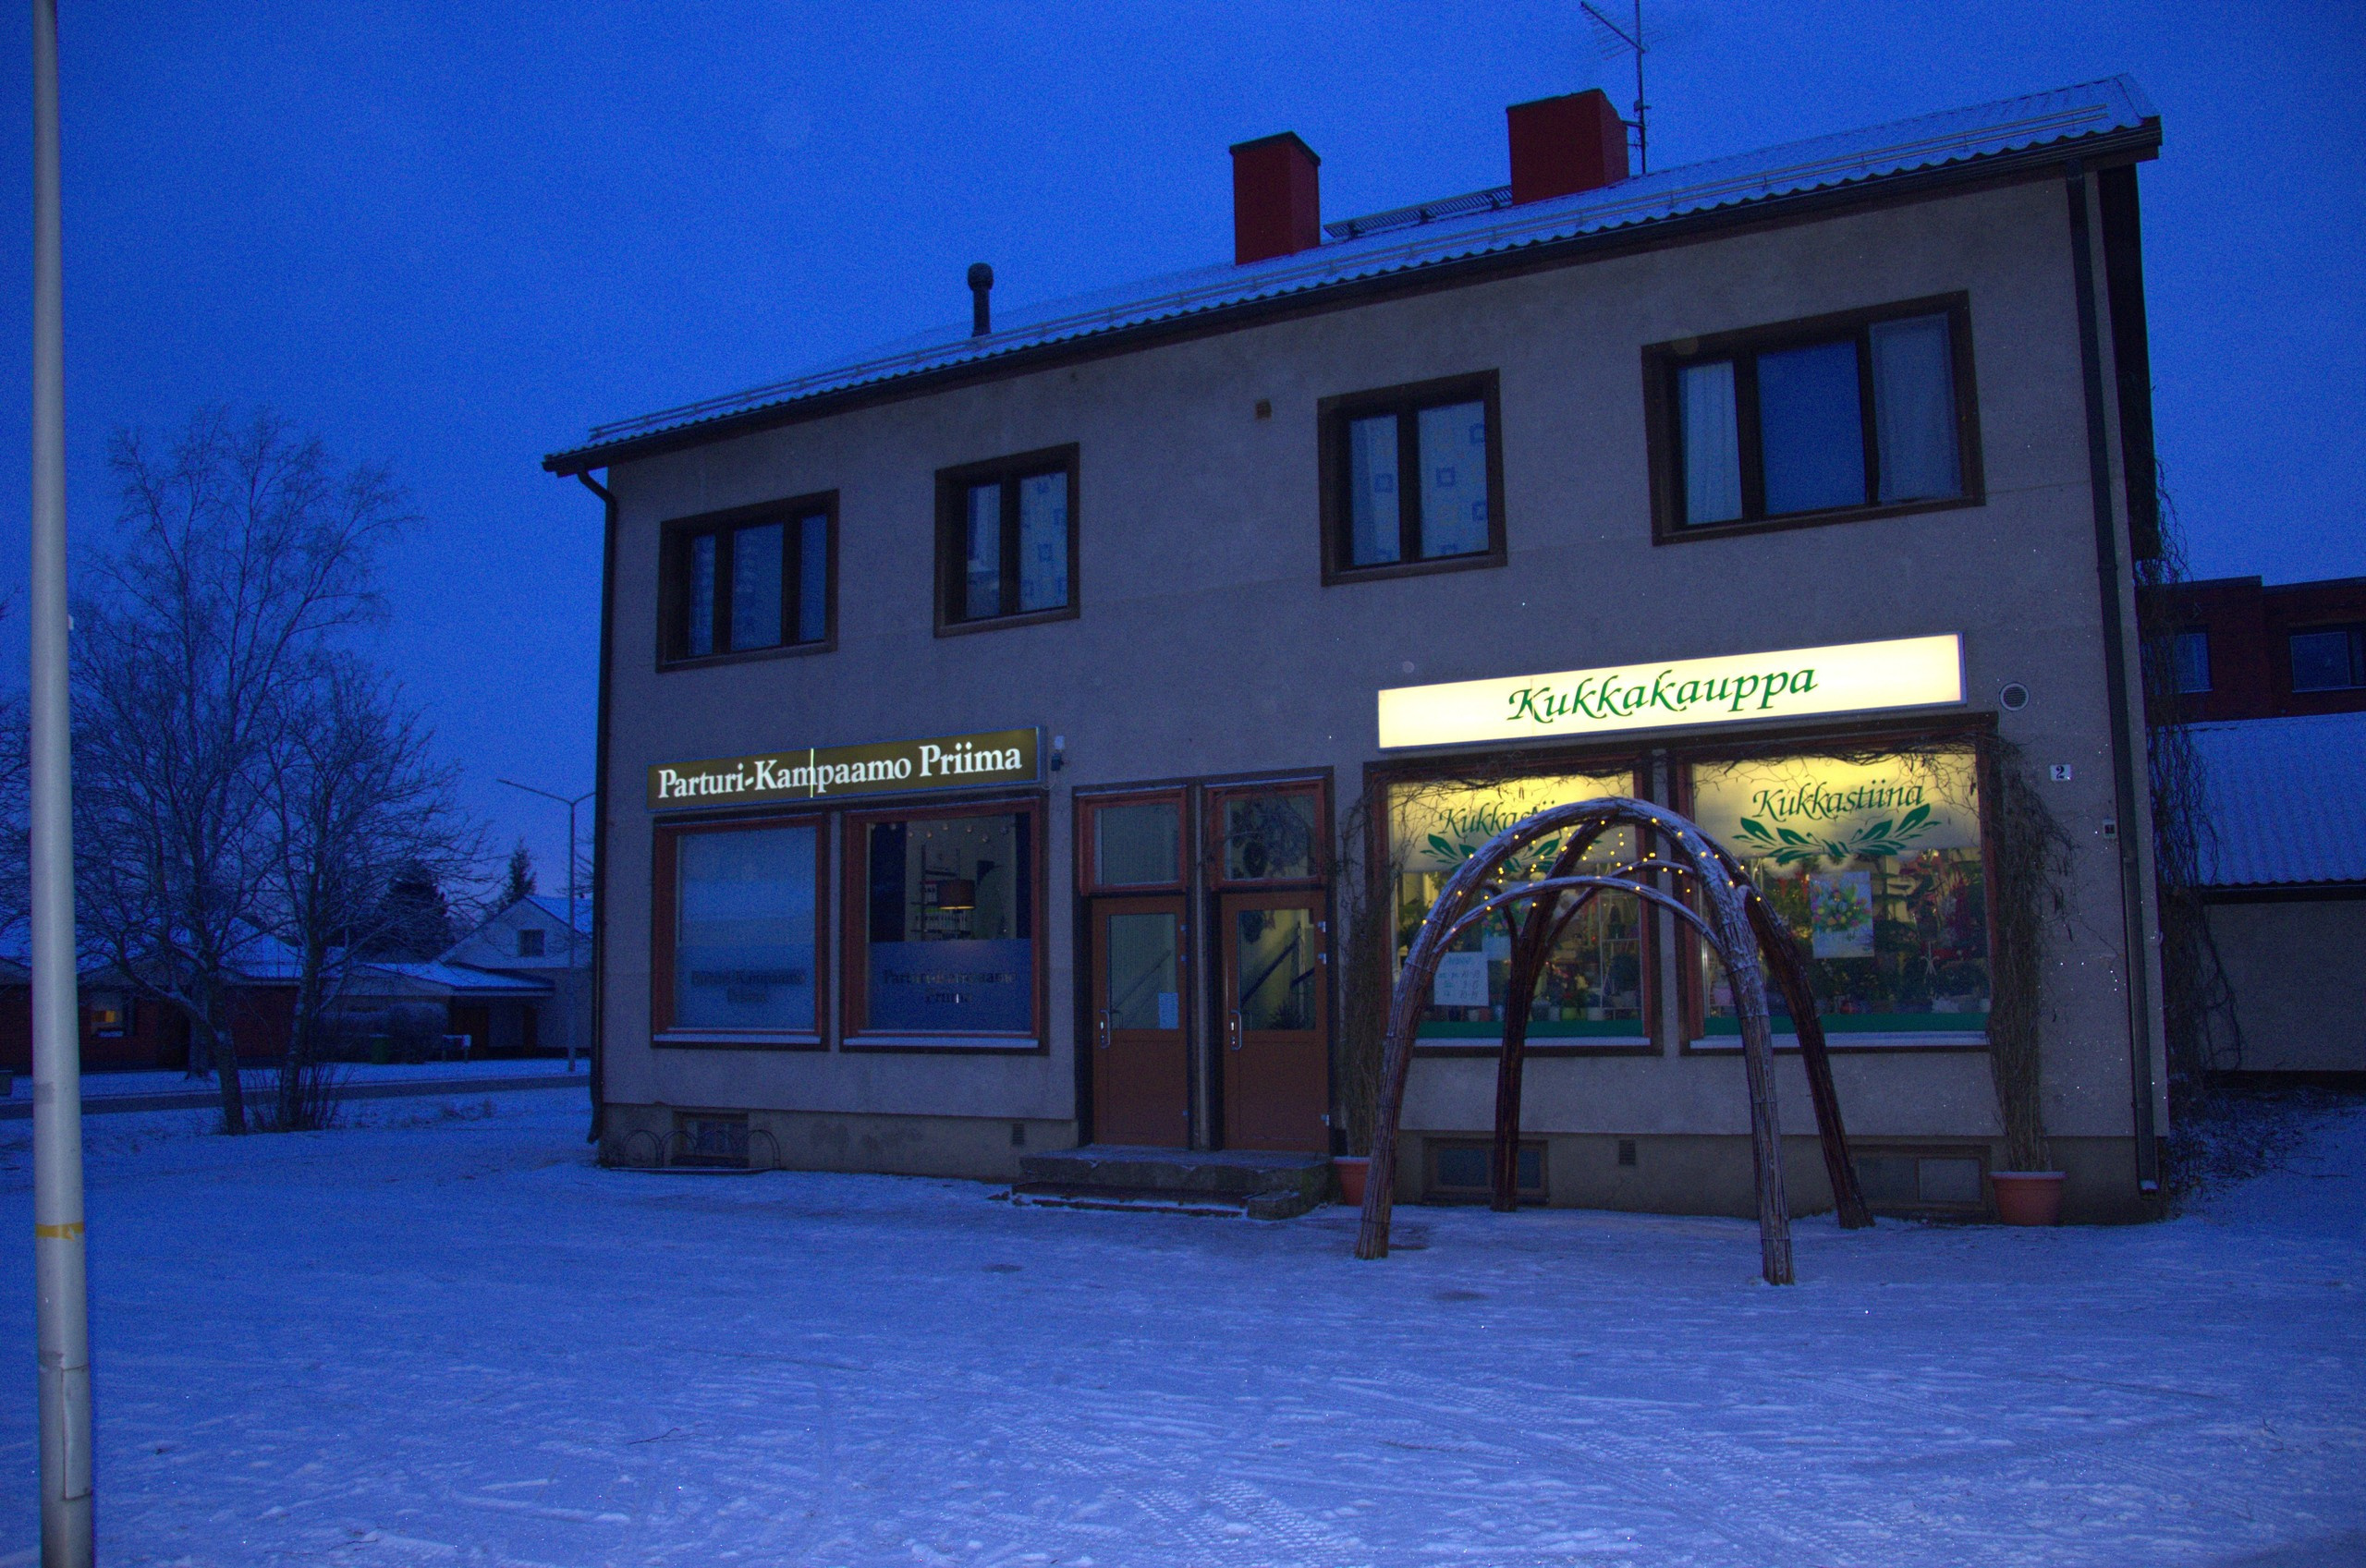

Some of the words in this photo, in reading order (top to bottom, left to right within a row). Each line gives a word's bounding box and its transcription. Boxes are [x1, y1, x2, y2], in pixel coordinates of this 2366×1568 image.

[1507, 668, 1818, 723] Kukkakauppa
[658, 756, 912, 798] Parturi-Kampaamo
[919, 742, 1023, 777] Priima
[2055, 765, 2066, 780] 2
[1751, 778, 1925, 823] Kukkastiina
